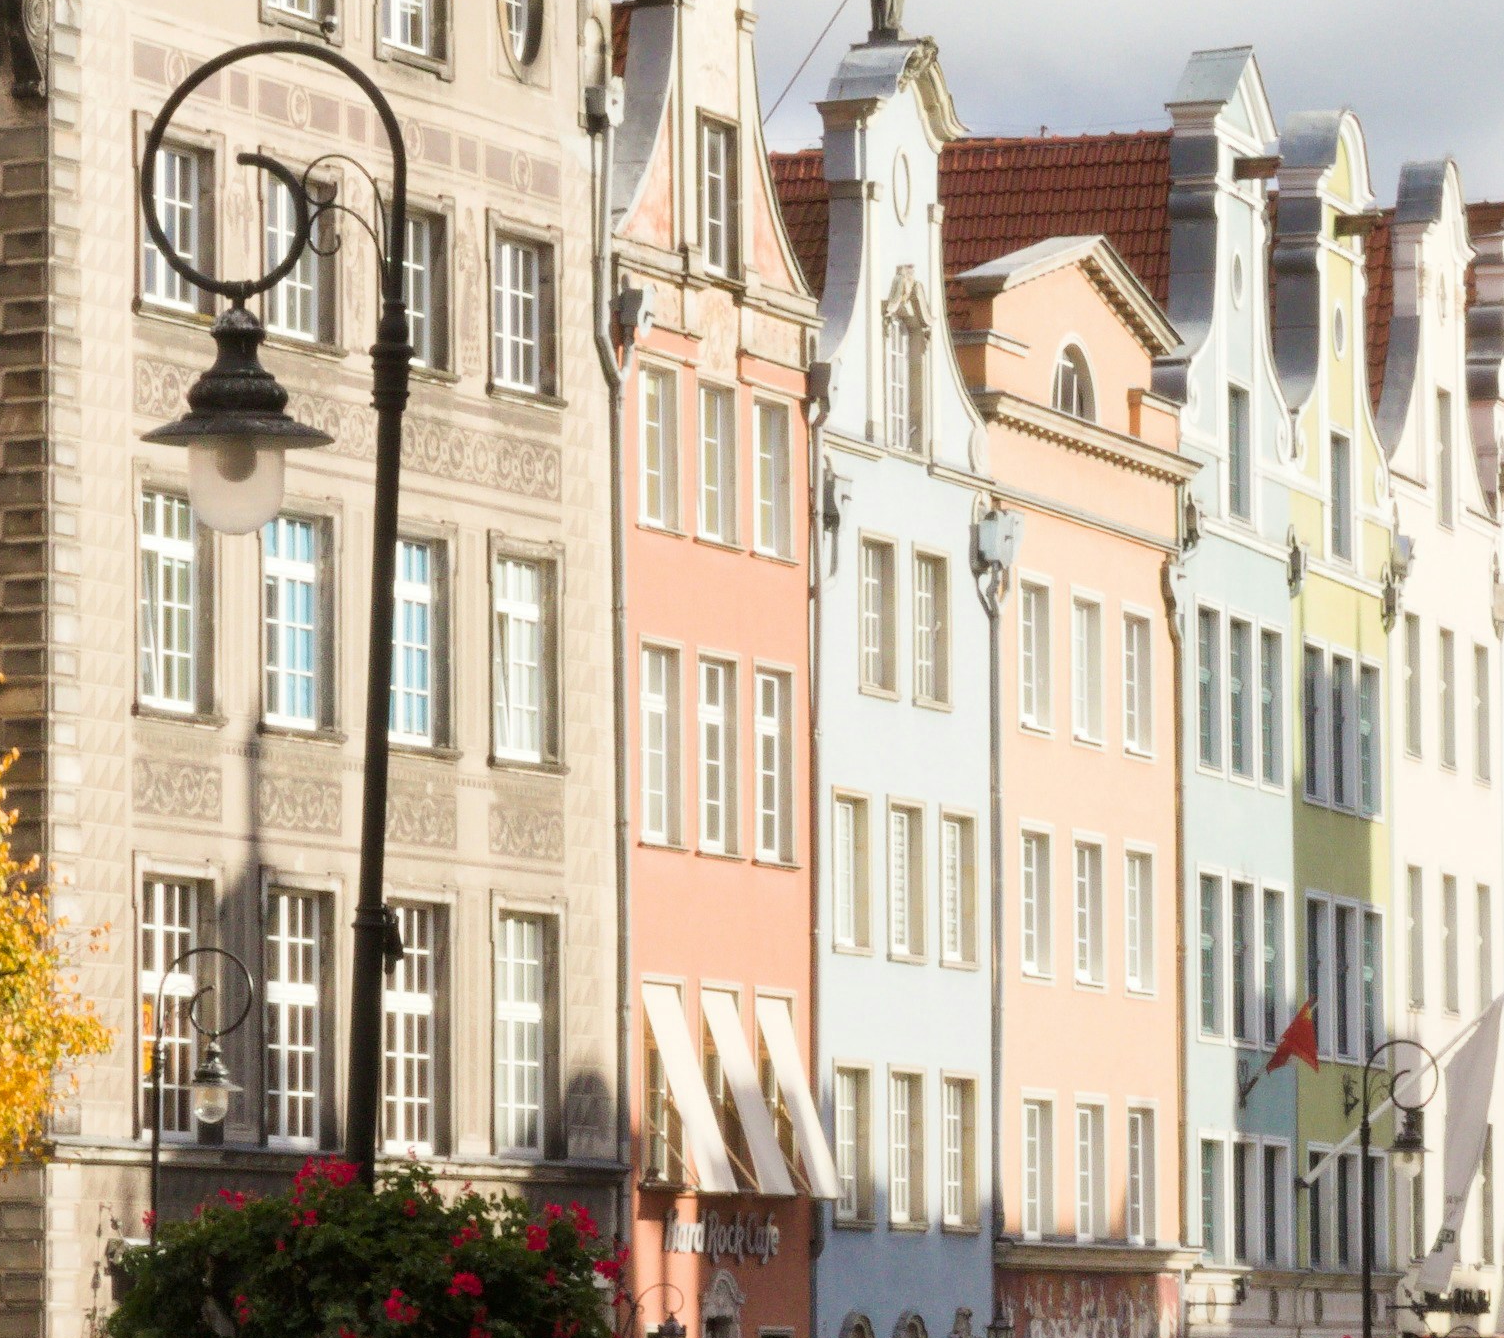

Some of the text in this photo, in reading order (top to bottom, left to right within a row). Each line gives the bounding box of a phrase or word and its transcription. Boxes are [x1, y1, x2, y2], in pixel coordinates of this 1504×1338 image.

[663, 1208, 780, 1265] Hard Rock Cafe
